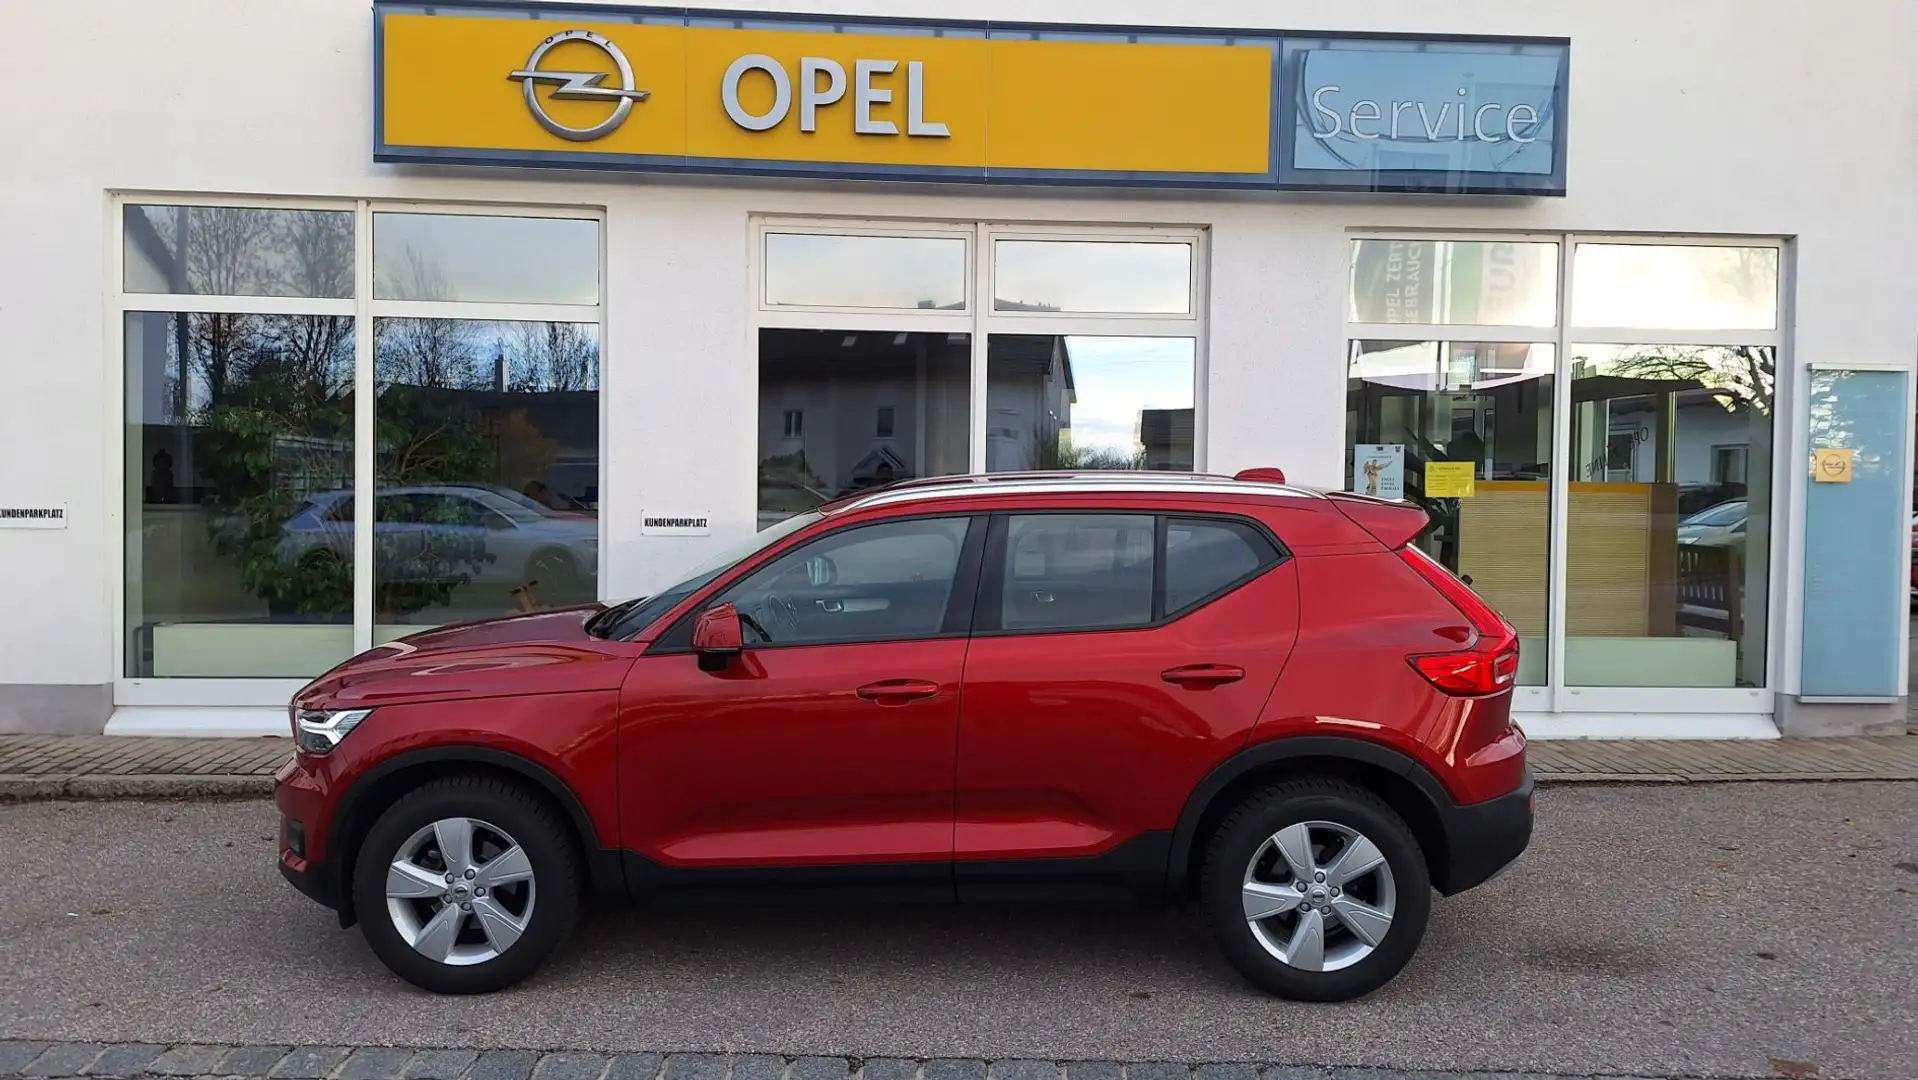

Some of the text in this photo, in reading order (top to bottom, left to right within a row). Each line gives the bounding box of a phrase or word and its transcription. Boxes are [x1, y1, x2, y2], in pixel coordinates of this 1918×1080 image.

[544, 30, 613, 48] OPEL
[722, 54, 951, 137] OPEL
[1312, 85, 1538, 144] Service
[644, 518, 707, 527] KUNDENPARKPLATZ
